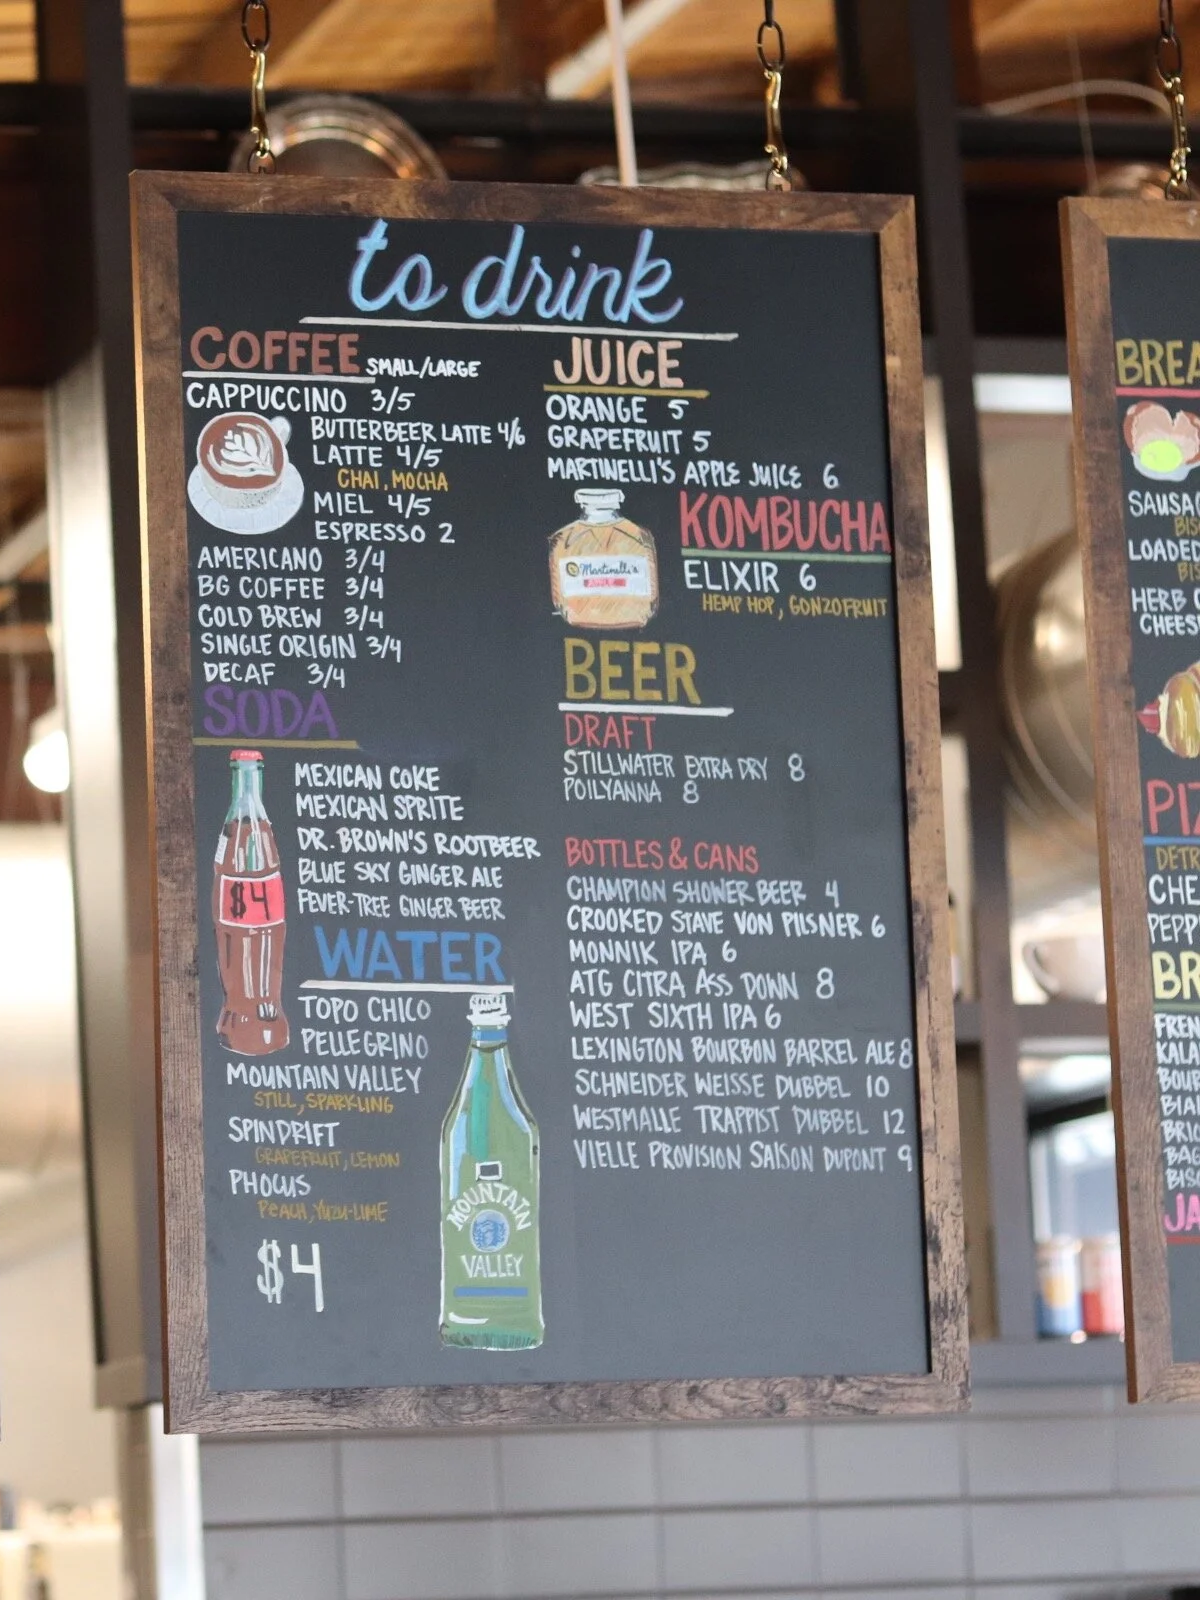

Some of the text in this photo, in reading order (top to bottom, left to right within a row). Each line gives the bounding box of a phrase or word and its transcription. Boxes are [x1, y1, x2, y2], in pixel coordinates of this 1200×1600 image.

[349, 219, 683, 324] to drink
[190, 326, 481, 379] COFFEE SMALL/LARGE
[553, 336, 684, 388] JUICE
[186, 383, 415, 414] CAPPUCCINO 3/5
[546, 394, 689, 424] ORANGE 5
[311, 416, 525, 449] BUTTERBEER LATTE 4/6
[548, 426, 711, 455] GRAPEFRUIT 5
[313, 445, 443, 468] LATTE 4/5
[548, 457, 838, 489] MARTINELLI'S APPLE JUICE 6
[314, 492, 432, 518] MIEL 4/5
[315, 521, 455, 543] ESPRESSO 2
[679, 490, 892, 553] KOMBUCHA
[198, 546, 385, 573] AMERICANO 3/4
[684, 559, 816, 593] ELIXIR 6
[703, 594, 742, 611] HEMP
[789, 598, 887, 618] GONZOFRUIT
[1131, 587, 1187, 612] HERB
[198, 604, 383, 630] COLD BREW 3/4
[201, 634, 401, 662] SINGLE ORIGIN 3/4
[564, 637, 701, 705] BEER
[203, 684, 339, 739] SODA
[564, 714, 656, 750] DRAFT
[295, 763, 440, 791] MEXICAN COKE
[297, 827, 541, 859] DR. BROWN'S ROOTBEER
[566, 837, 759, 873] BOTTLES & CANS
[229, 881, 270, 921] $4
[567, 905, 885, 939] CROOKED STAVE VON PILSNER 6
[314, 925, 506, 982] WATER
[298, 995, 431, 1024] TOPO CHICO
[570, 1001, 781, 1030] WEST SIXTH IPA 6
[227, 1063, 422, 1093] MOUNTAIN VALLEY
[575, 1069, 889, 1099] SCHNEIDER WEISSE DUBBEL 10
[229, 1116, 340, 1146] SPINDRIFT
[229, 1169, 311, 1198] PHOCUS
[446, 1183, 531, 1231] MOUNTAIN
[257, 1239, 324, 1312] $4
[460, 1253, 523, 1278] VALLEY
